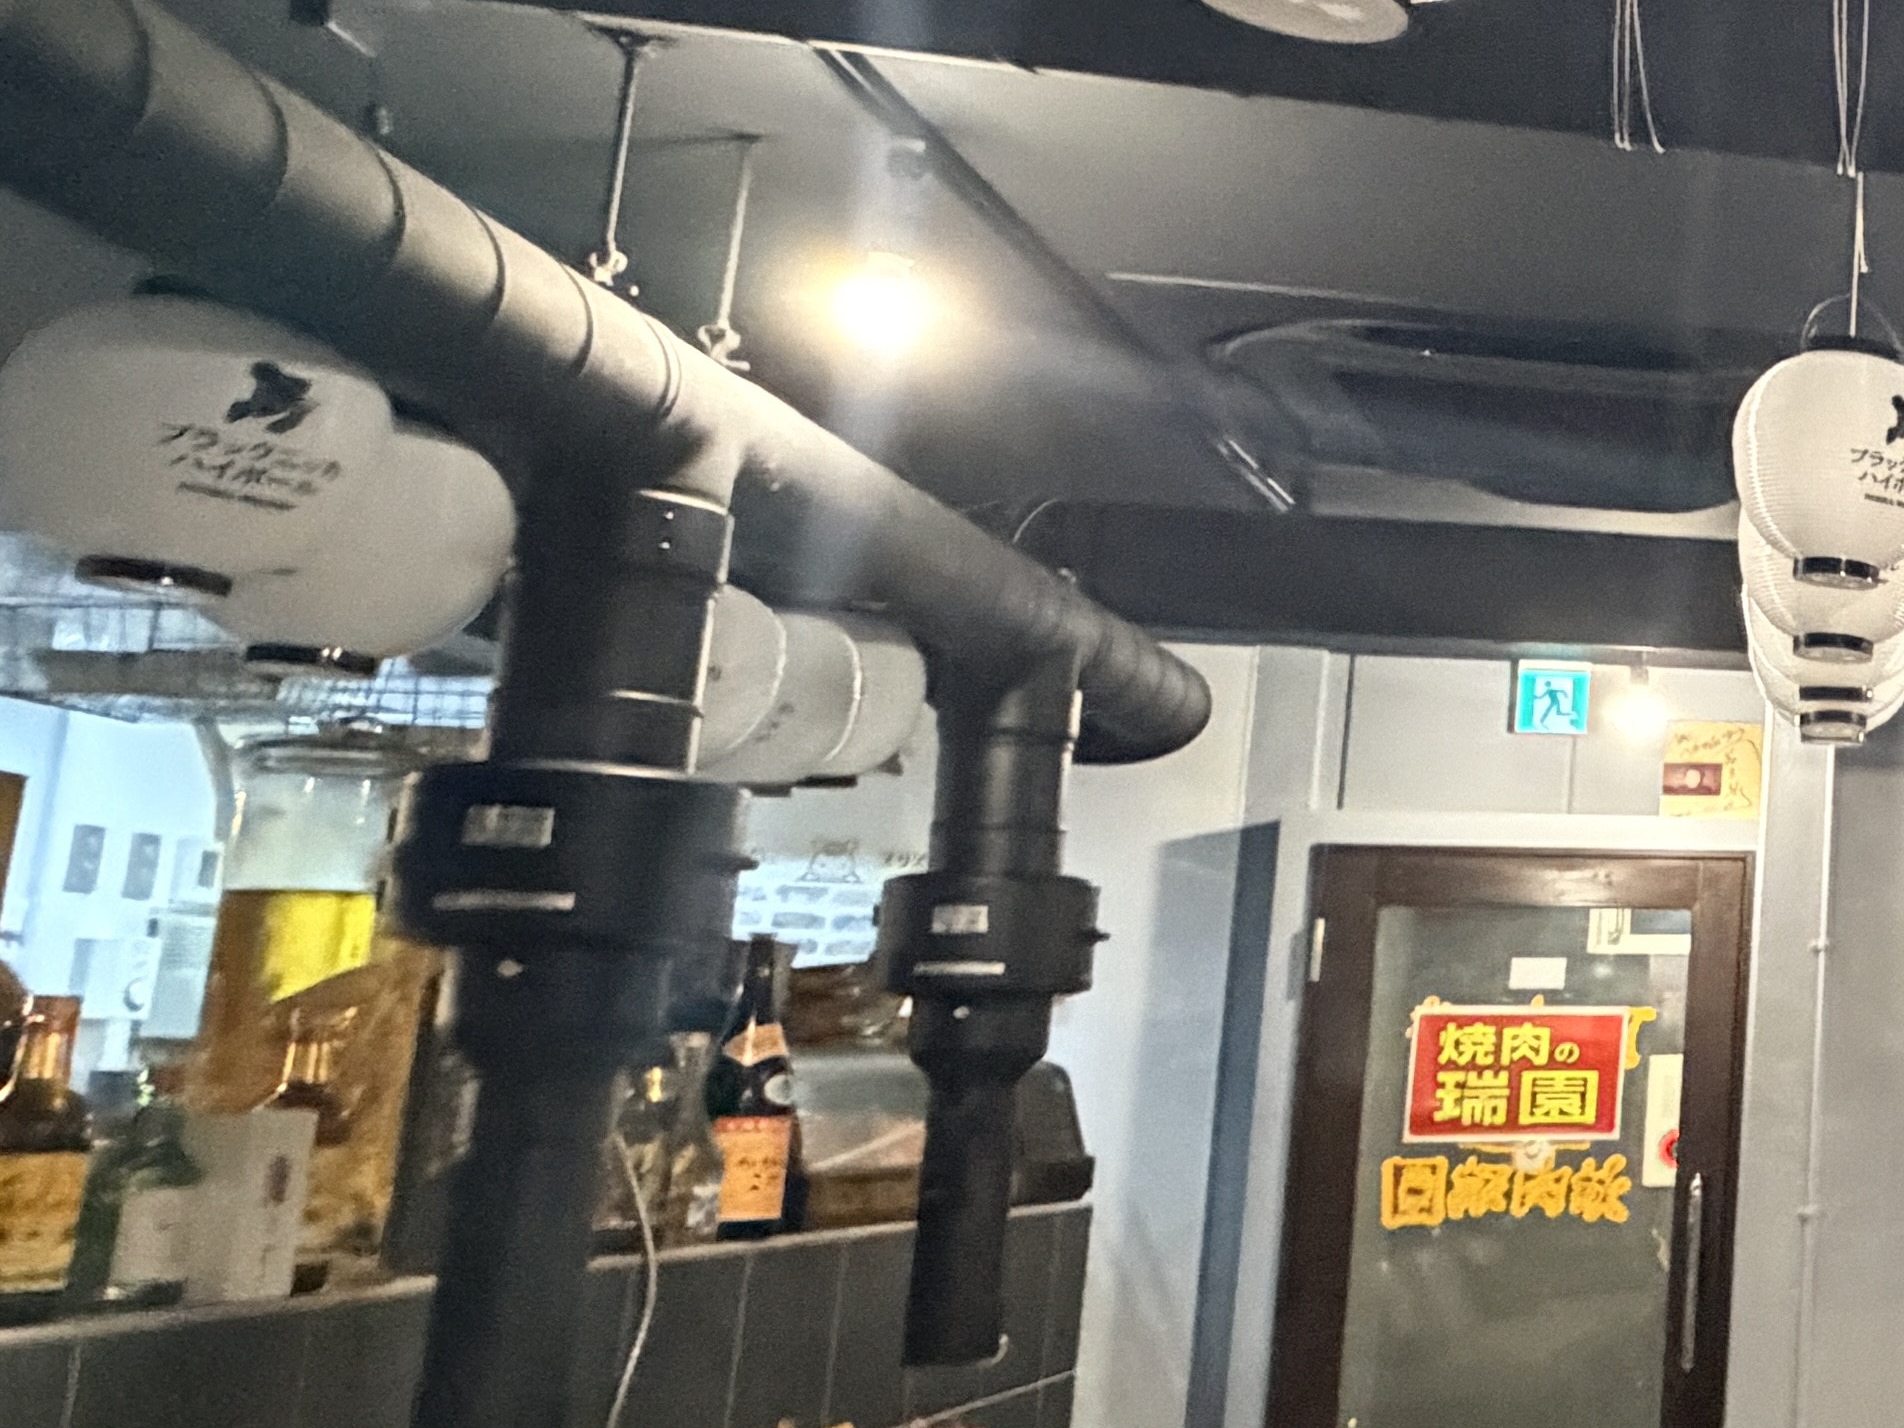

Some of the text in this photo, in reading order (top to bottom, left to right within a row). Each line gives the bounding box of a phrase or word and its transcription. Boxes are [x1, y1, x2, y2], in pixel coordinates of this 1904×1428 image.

[1437, 1021, 1581, 1067] 焼肉の
[1432, 1069, 1600, 1127] 瑞園
